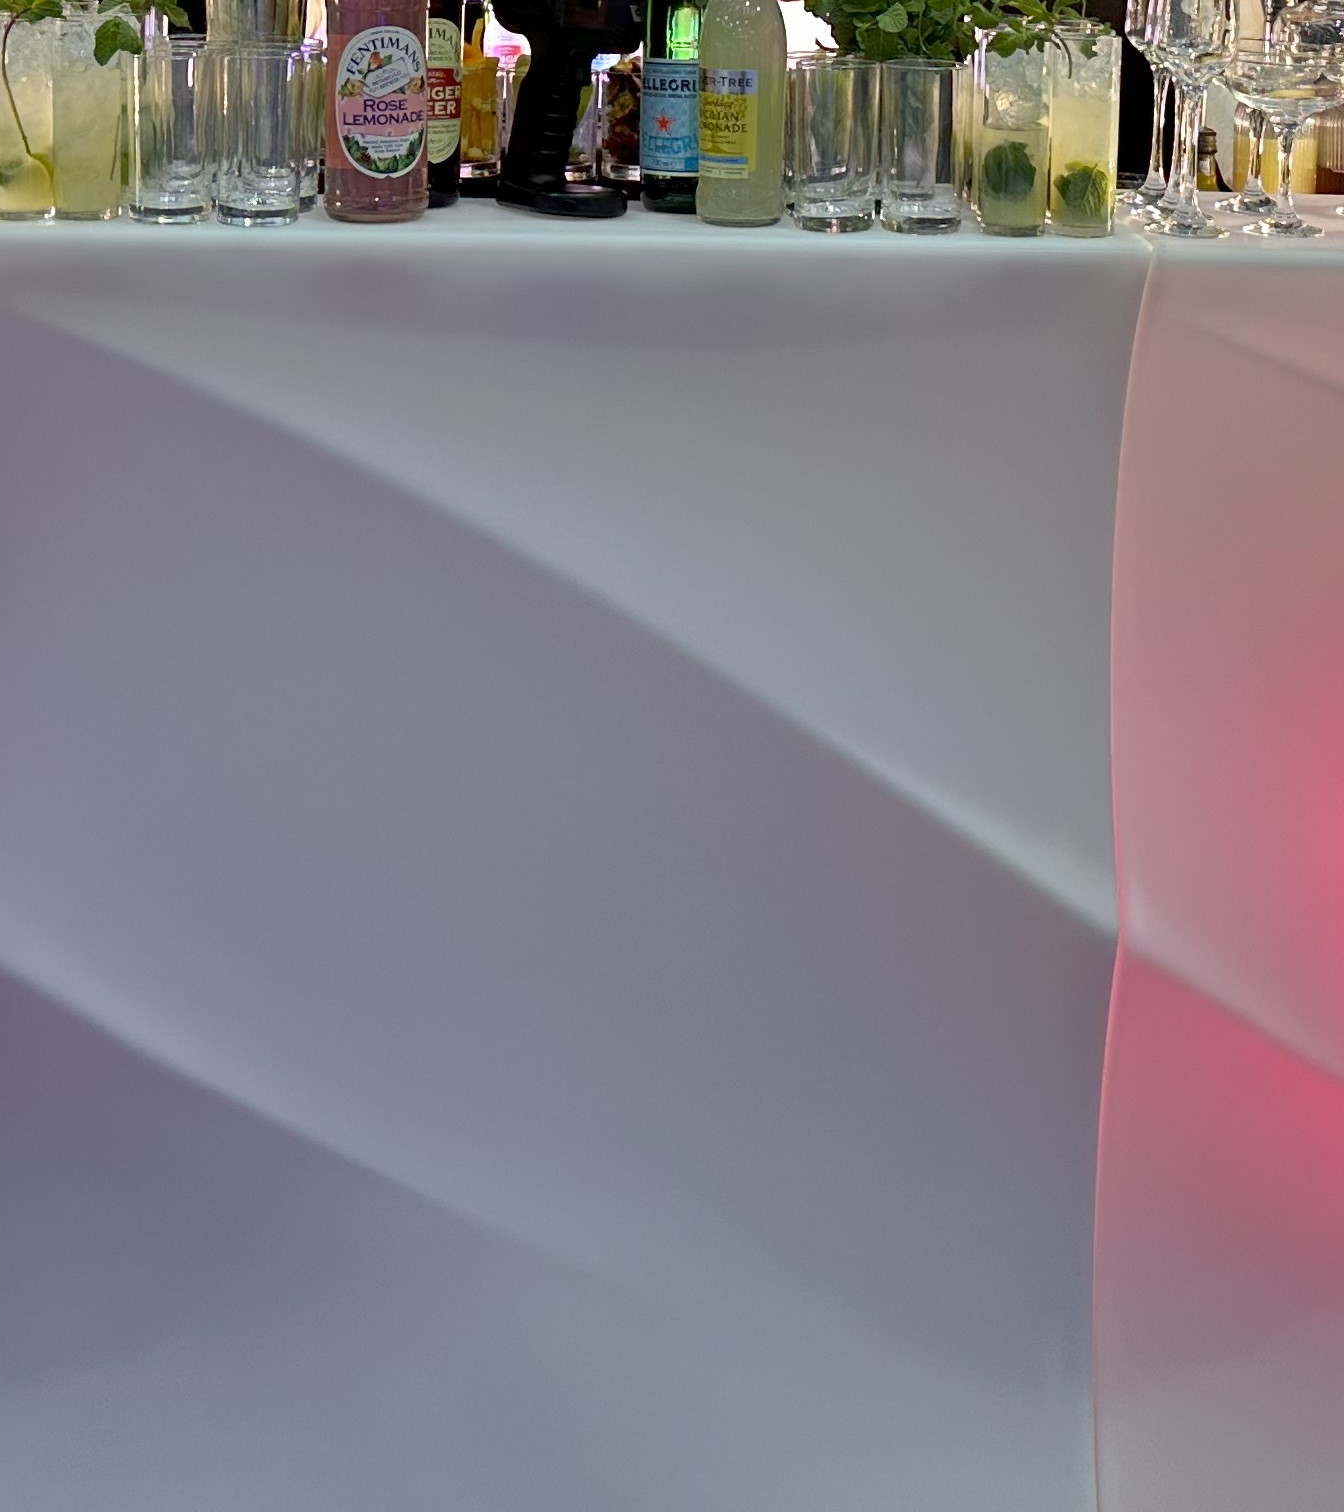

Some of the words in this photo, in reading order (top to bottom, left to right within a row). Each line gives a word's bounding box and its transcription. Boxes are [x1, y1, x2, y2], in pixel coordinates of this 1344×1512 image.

[346, 36, 421, 76] FENTIMANS
[363, 98, 408, 112] ROSE
[343, 110, 424, 126] LEMONADE
